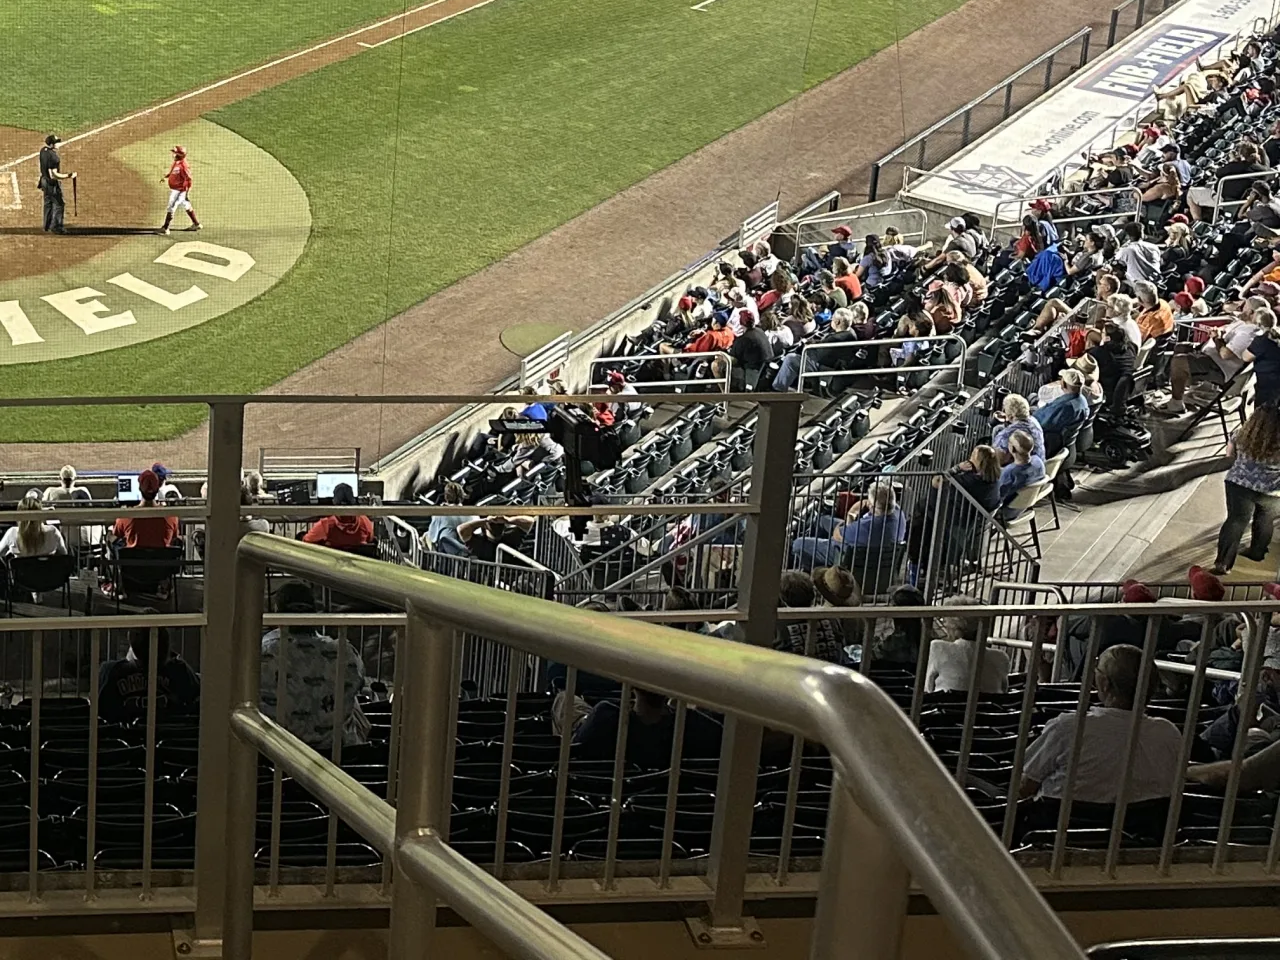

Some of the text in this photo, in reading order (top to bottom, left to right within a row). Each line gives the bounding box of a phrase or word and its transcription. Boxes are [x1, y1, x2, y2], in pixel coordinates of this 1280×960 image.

[1092, 28, 1219, 97] FNB FIELD
[1021, 110, 1101, 157] fnb-online.com
